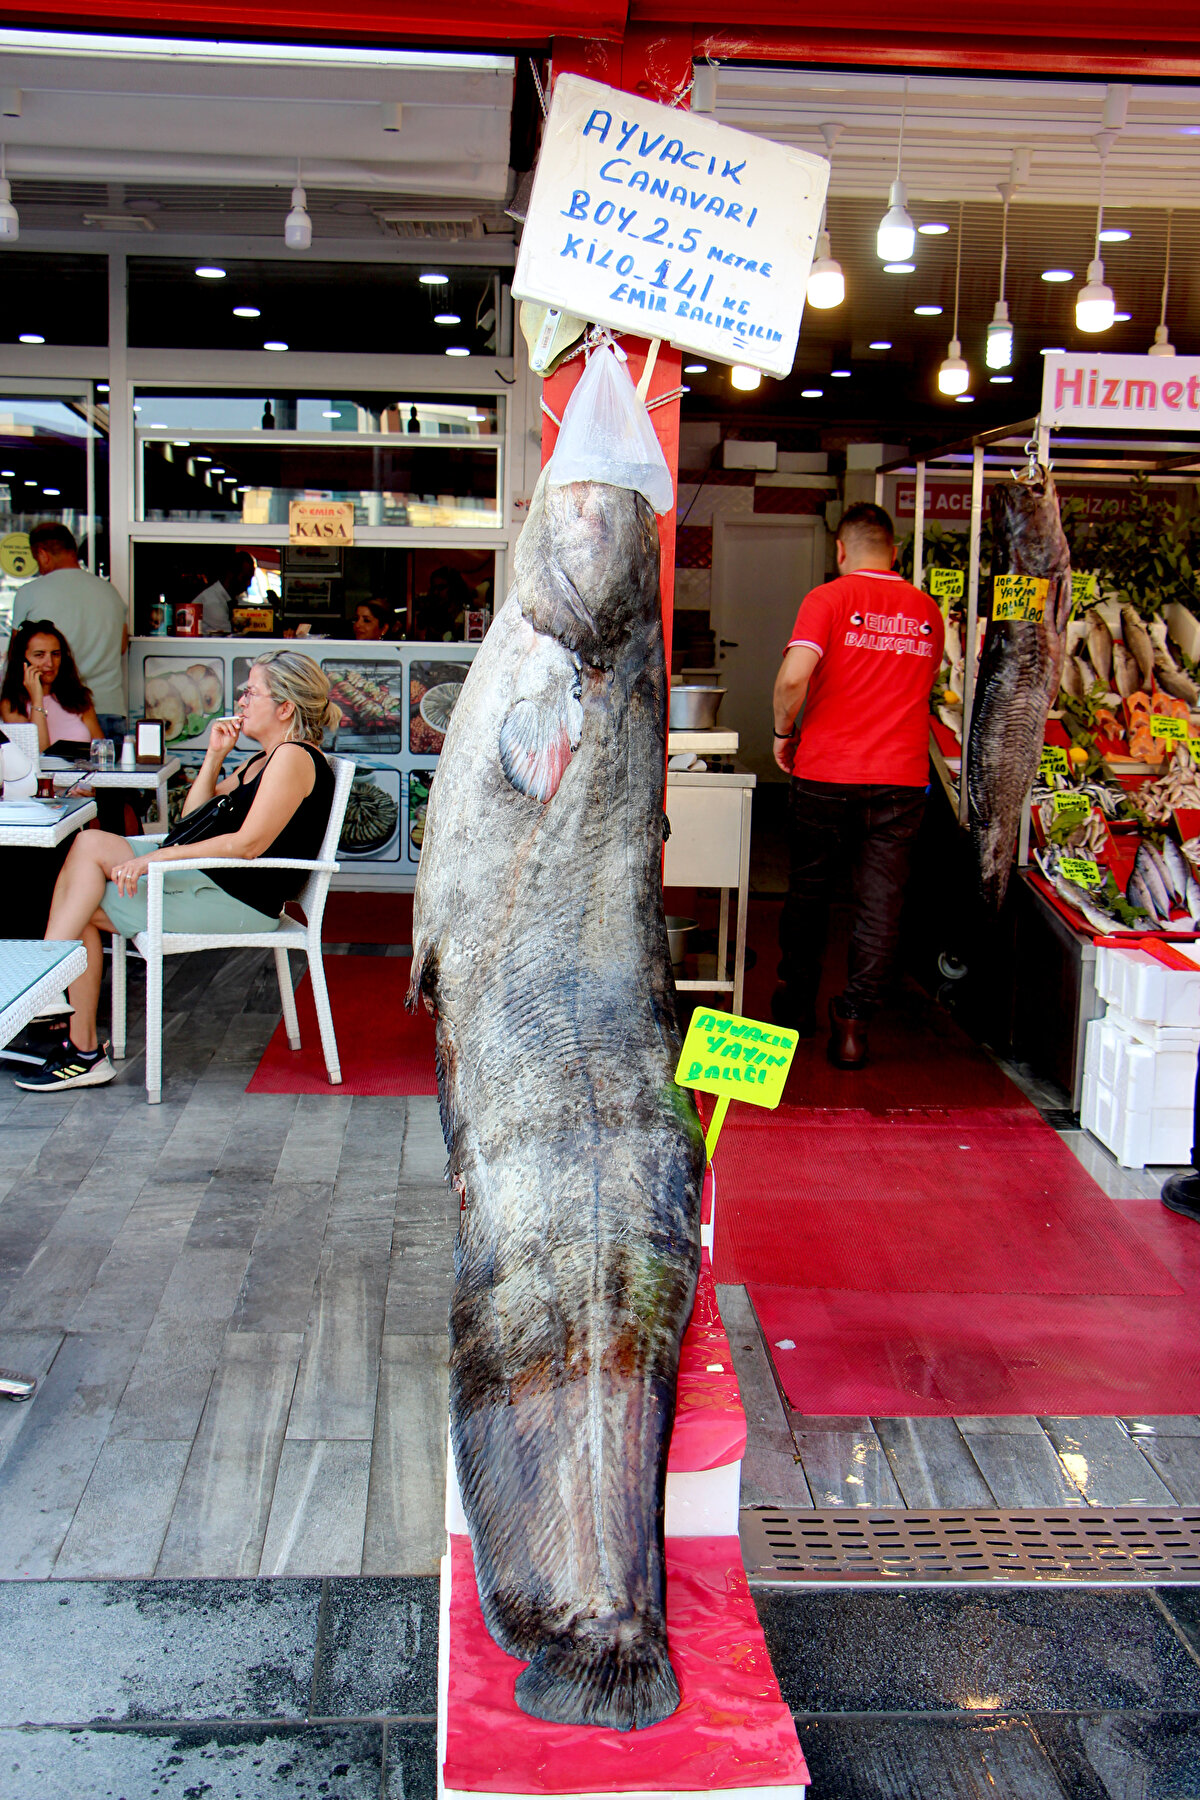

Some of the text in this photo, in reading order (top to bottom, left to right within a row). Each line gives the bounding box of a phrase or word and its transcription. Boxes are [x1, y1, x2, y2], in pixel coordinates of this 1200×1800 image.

[582, 109, 747, 186] AYVACIK
[599, 158, 758, 228] CANAVARI
[706, 246, 773, 278] METRE
[609, 283, 667, 313] EMİR
[1054, 367, 1200, 412] Hizmet
[296, 522, 347, 538] KASA
[1000, 587, 1036, 599] YAYIN
[864, 612, 919, 636] EMİR
[844, 631, 933, 657] BALIKÇILIK
[706, 1035, 788, 1067] YAYIN
